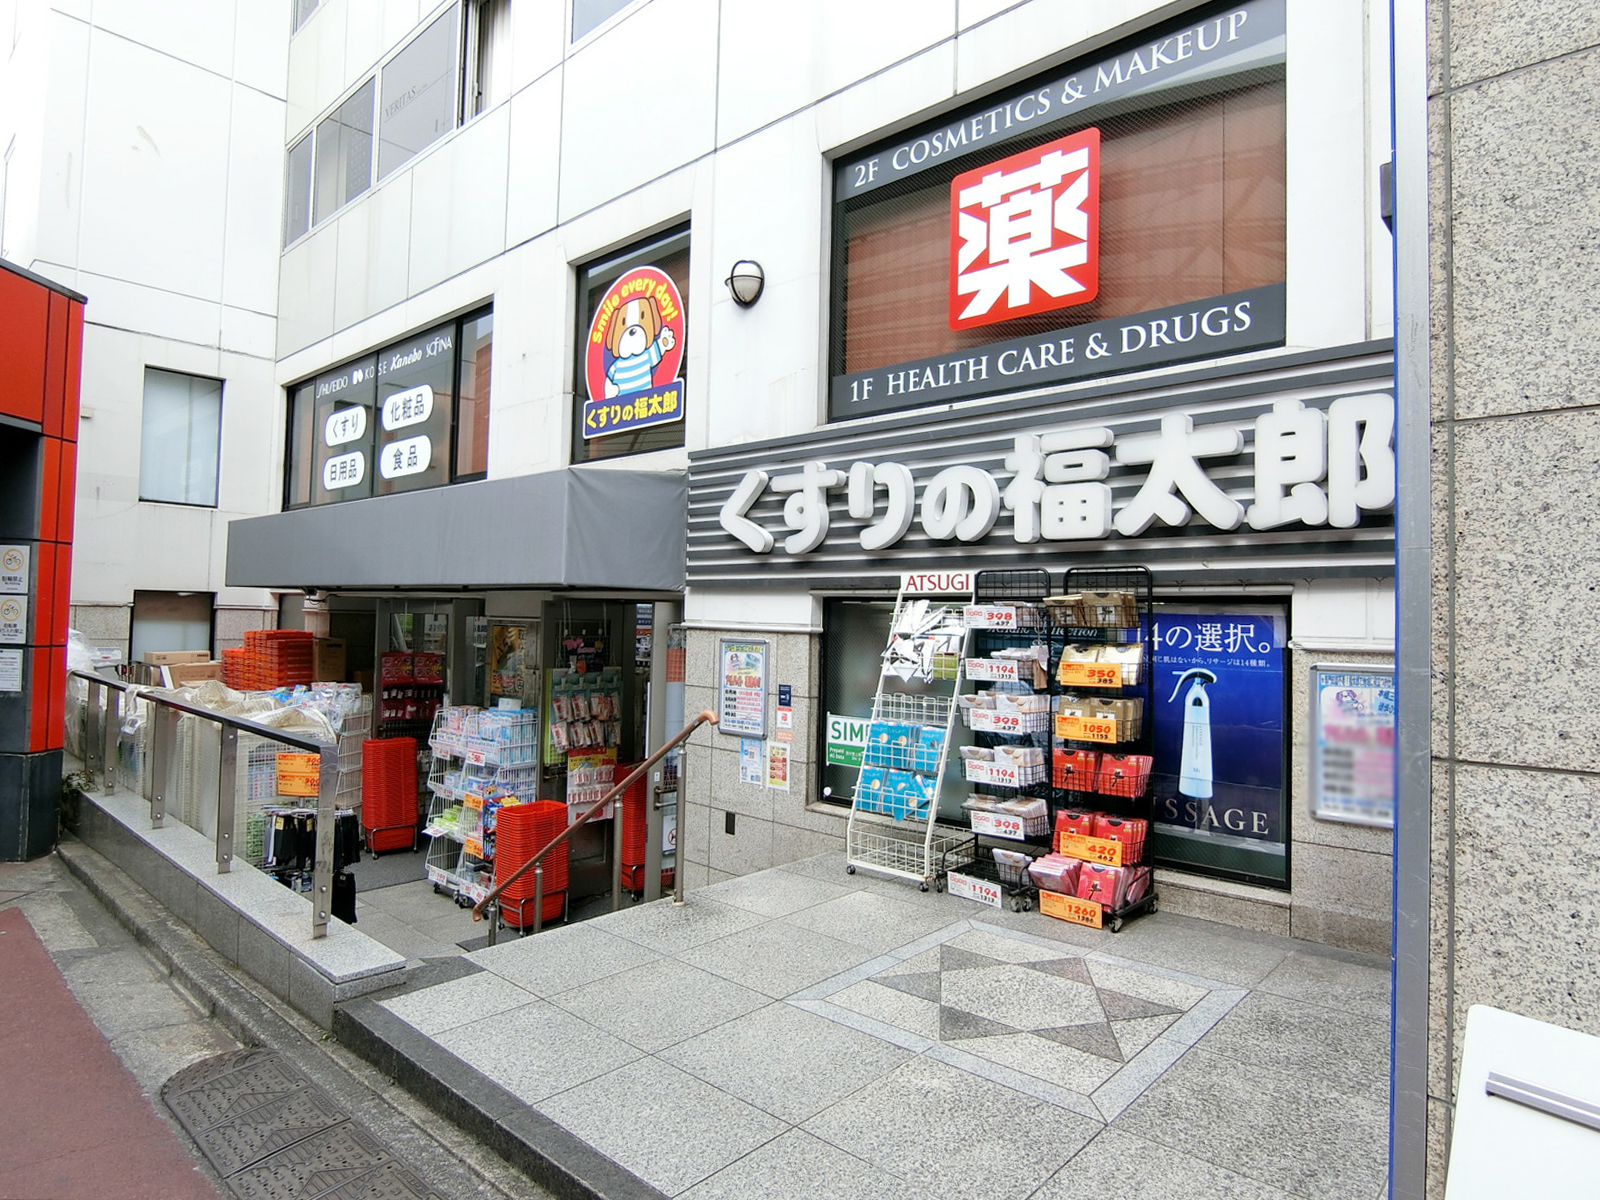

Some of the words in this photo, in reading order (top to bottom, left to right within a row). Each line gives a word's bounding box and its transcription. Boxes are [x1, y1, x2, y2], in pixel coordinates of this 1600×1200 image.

[854, 159, 880, 188] 2F
[892, 88, 1051, 172] COSMETICS
[1060, 77, 1087, 105] &
[1093, 9, 1250, 93] MAKEUP
[957, 147, 1089, 321] 薬
[850, 378, 876, 404] 1F
[887, 356, 989, 397] HEALTH
[997, 337, 1075, 375] CARE
[1084, 331, 1110, 360] &
[1120, 301, 1252, 354] DRUGS
[316, 375, 348, 398] SHISEIDO
[391, 347, 422, 371] Kanebo
[391, 393, 425, 423] 化粧品
[586, 390, 678, 429] くすりの福太郎
[332, 412, 359, 438] くすり
[392, 444, 418, 471] 食品
[330, 458, 357, 482] 日用品
[719, 392, 1395, 555] くすりの福太郎
[905, 573, 970, 591] ATSUGI
[986, 612, 1012, 621] 398
[989, 665, 1014, 675] 1194
[1086, 669, 1116, 678] 350
[993, 716, 1019, 726] 398
[1083, 724, 1111, 734] 1050
[989, 768, 1015, 779] 1194
[994, 819, 1020, 831] 398
[1087, 845, 1117, 856] 420
[1097, 854, 1114, 862] 462
[971, 884, 998, 899] 1194
[1067, 904, 1096, 918] 1260
